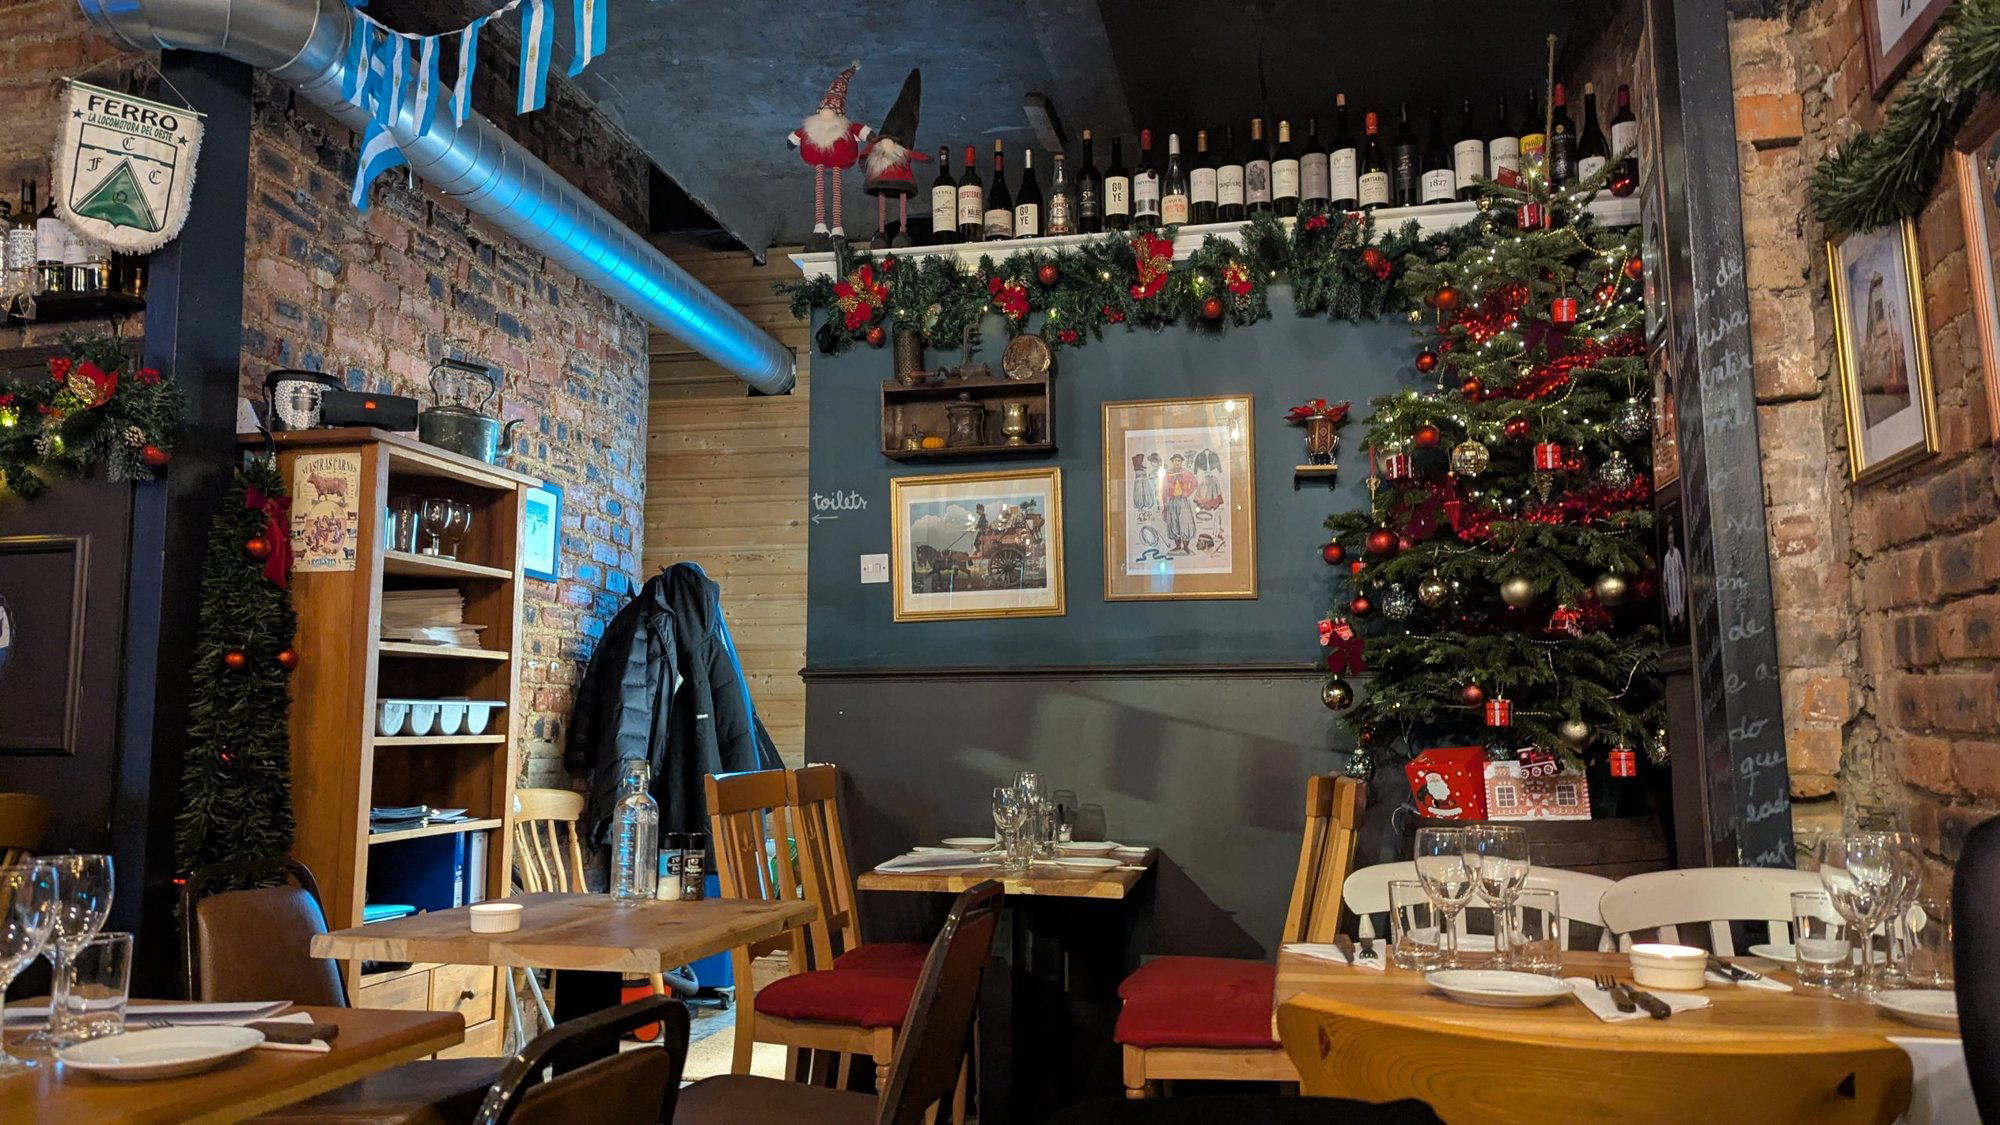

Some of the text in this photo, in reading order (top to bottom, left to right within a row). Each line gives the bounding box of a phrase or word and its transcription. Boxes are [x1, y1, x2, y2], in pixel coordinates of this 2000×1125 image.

[88, 95, 178, 131] FERRO
[88, 112, 174, 142] LA LOCOMOTORA DEL OESTE
[1112, 182, 1122, 192] GO
[1112, 192, 1122, 202] YE
[1020, 206, 1029, 216] GO
[1020, 215, 1029, 225] YE
[812, 489, 867, 510] toilets
